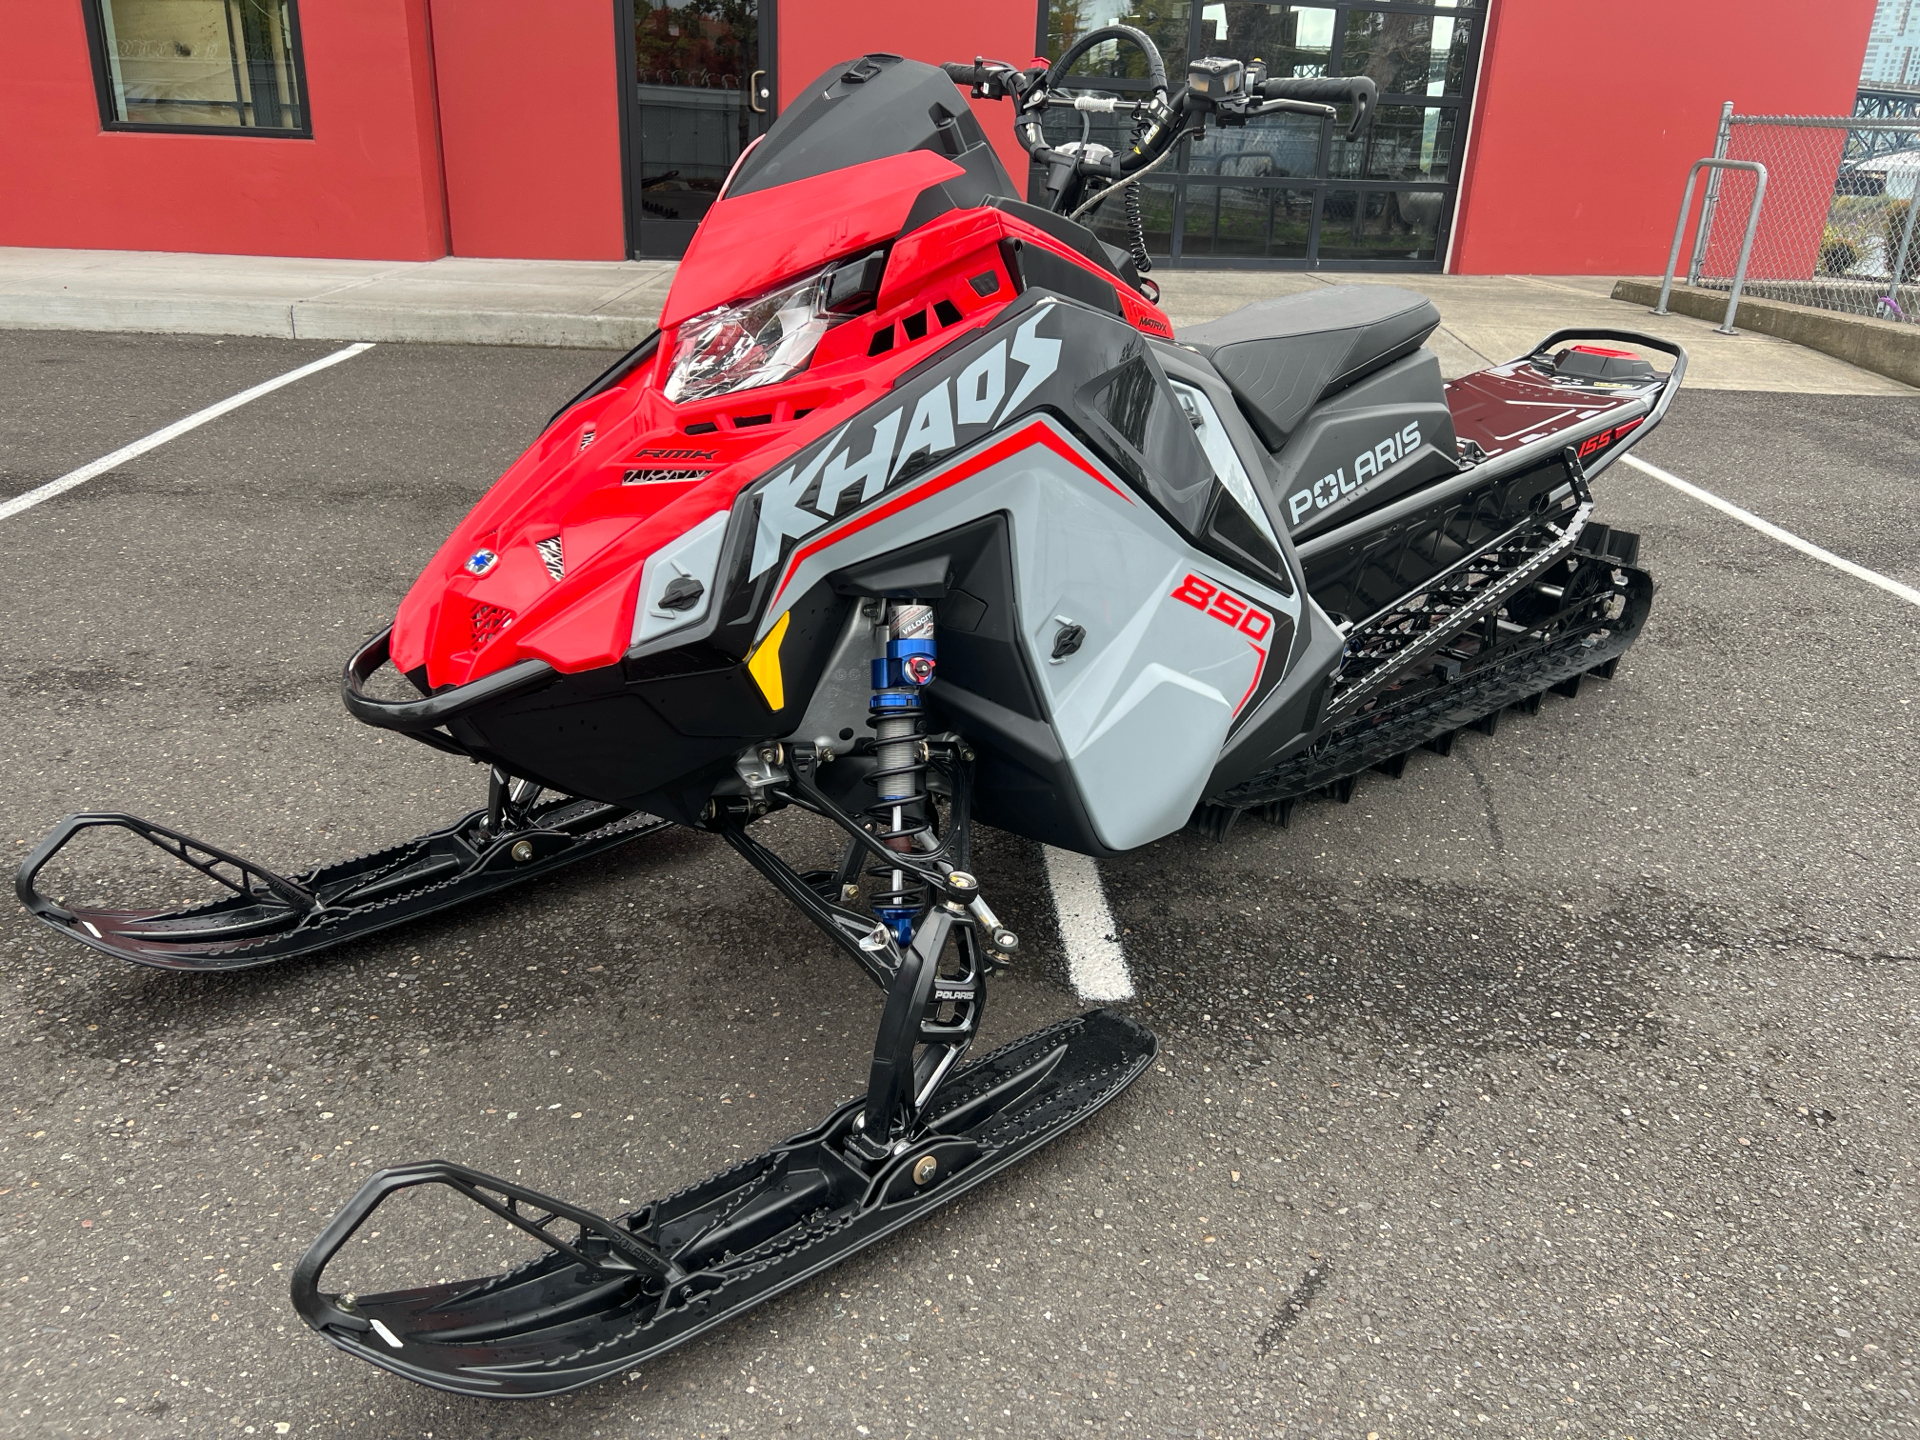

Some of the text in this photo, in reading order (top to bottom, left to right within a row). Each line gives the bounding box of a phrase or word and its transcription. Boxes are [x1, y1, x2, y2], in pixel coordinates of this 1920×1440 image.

[634, 449, 721, 460] RMK
[748, 304, 1063, 583] KHAOS
[1578, 429, 1613, 458] 155
[1288, 420, 1422, 526] POLARIS
[1170, 573, 1272, 642] 850
[935, 990, 975, 1000] POLARIS
